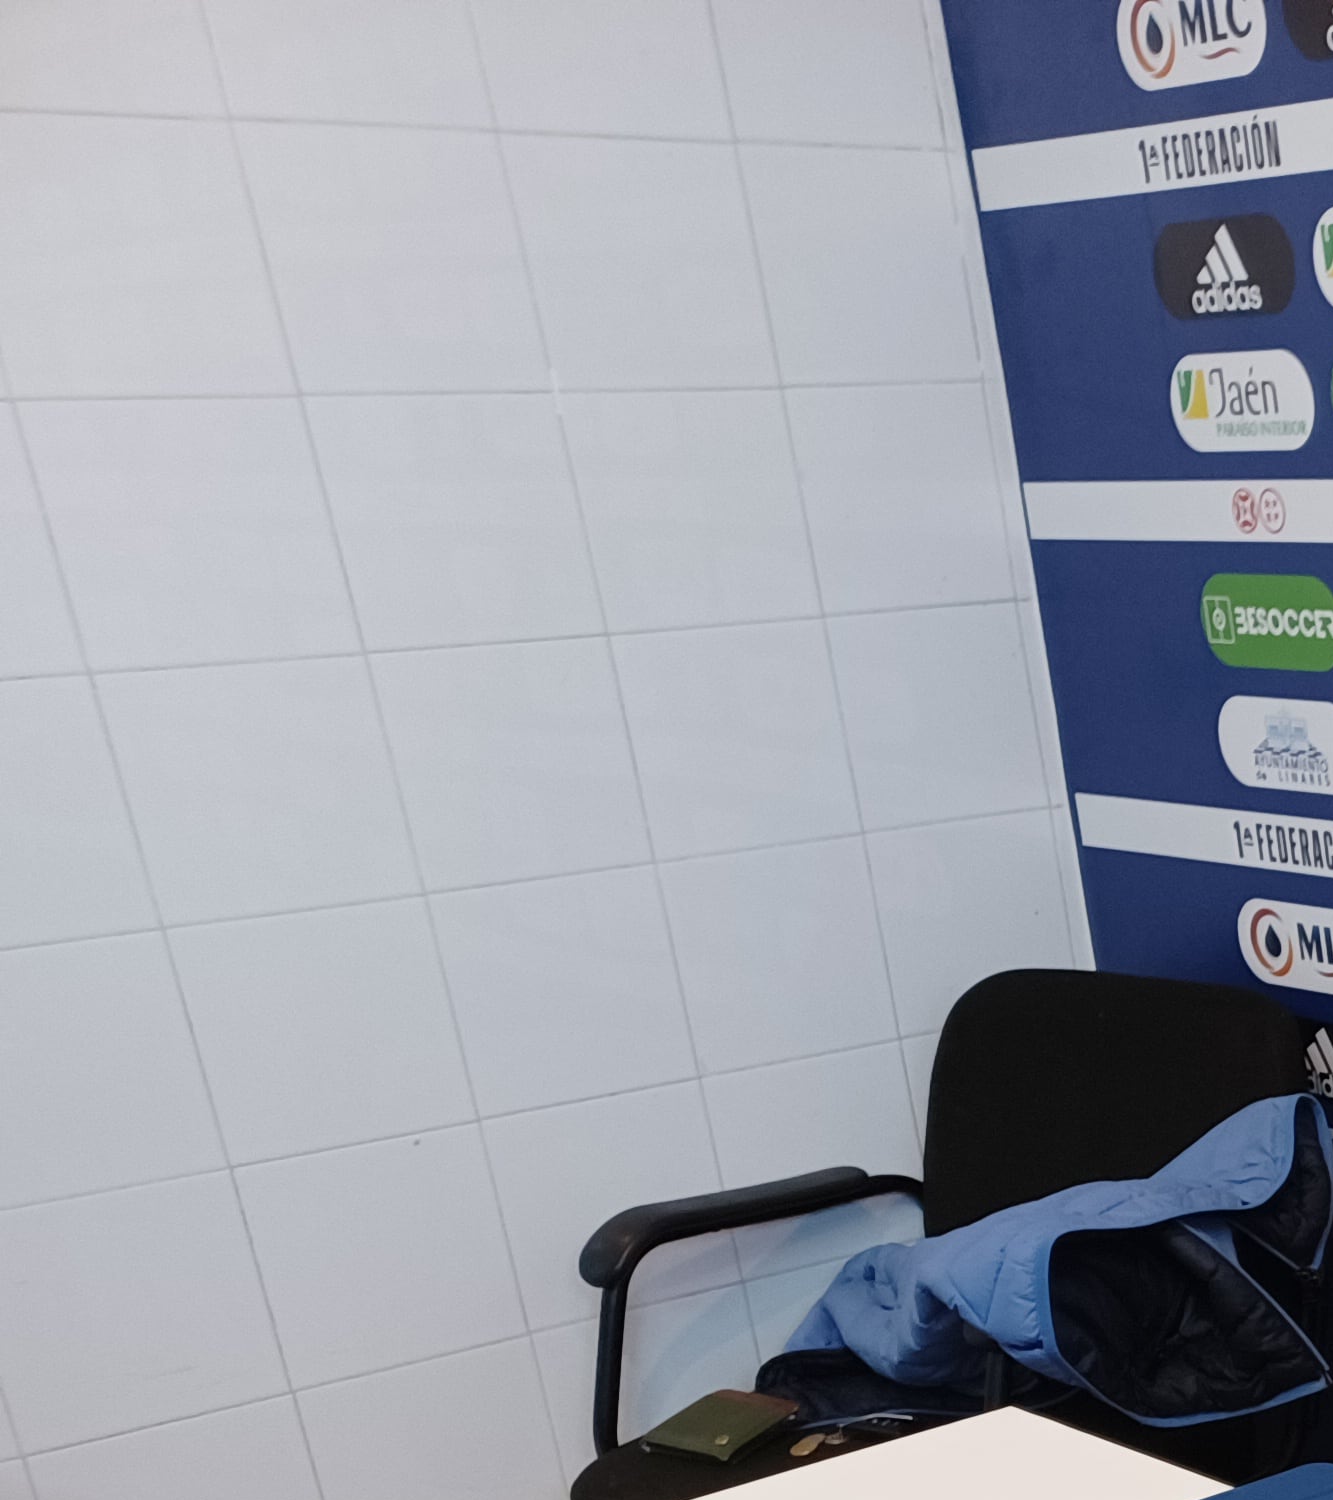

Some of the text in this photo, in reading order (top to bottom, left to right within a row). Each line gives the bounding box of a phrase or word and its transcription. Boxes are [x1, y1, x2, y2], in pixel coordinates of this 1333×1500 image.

[1179, 0, 1252, 47] MLC
[1161, 119, 1281, 181] FEDERACIÓN
[1192, 283, 1262, 315] adidas
[1210, 367, 1279, 416] Jaén
